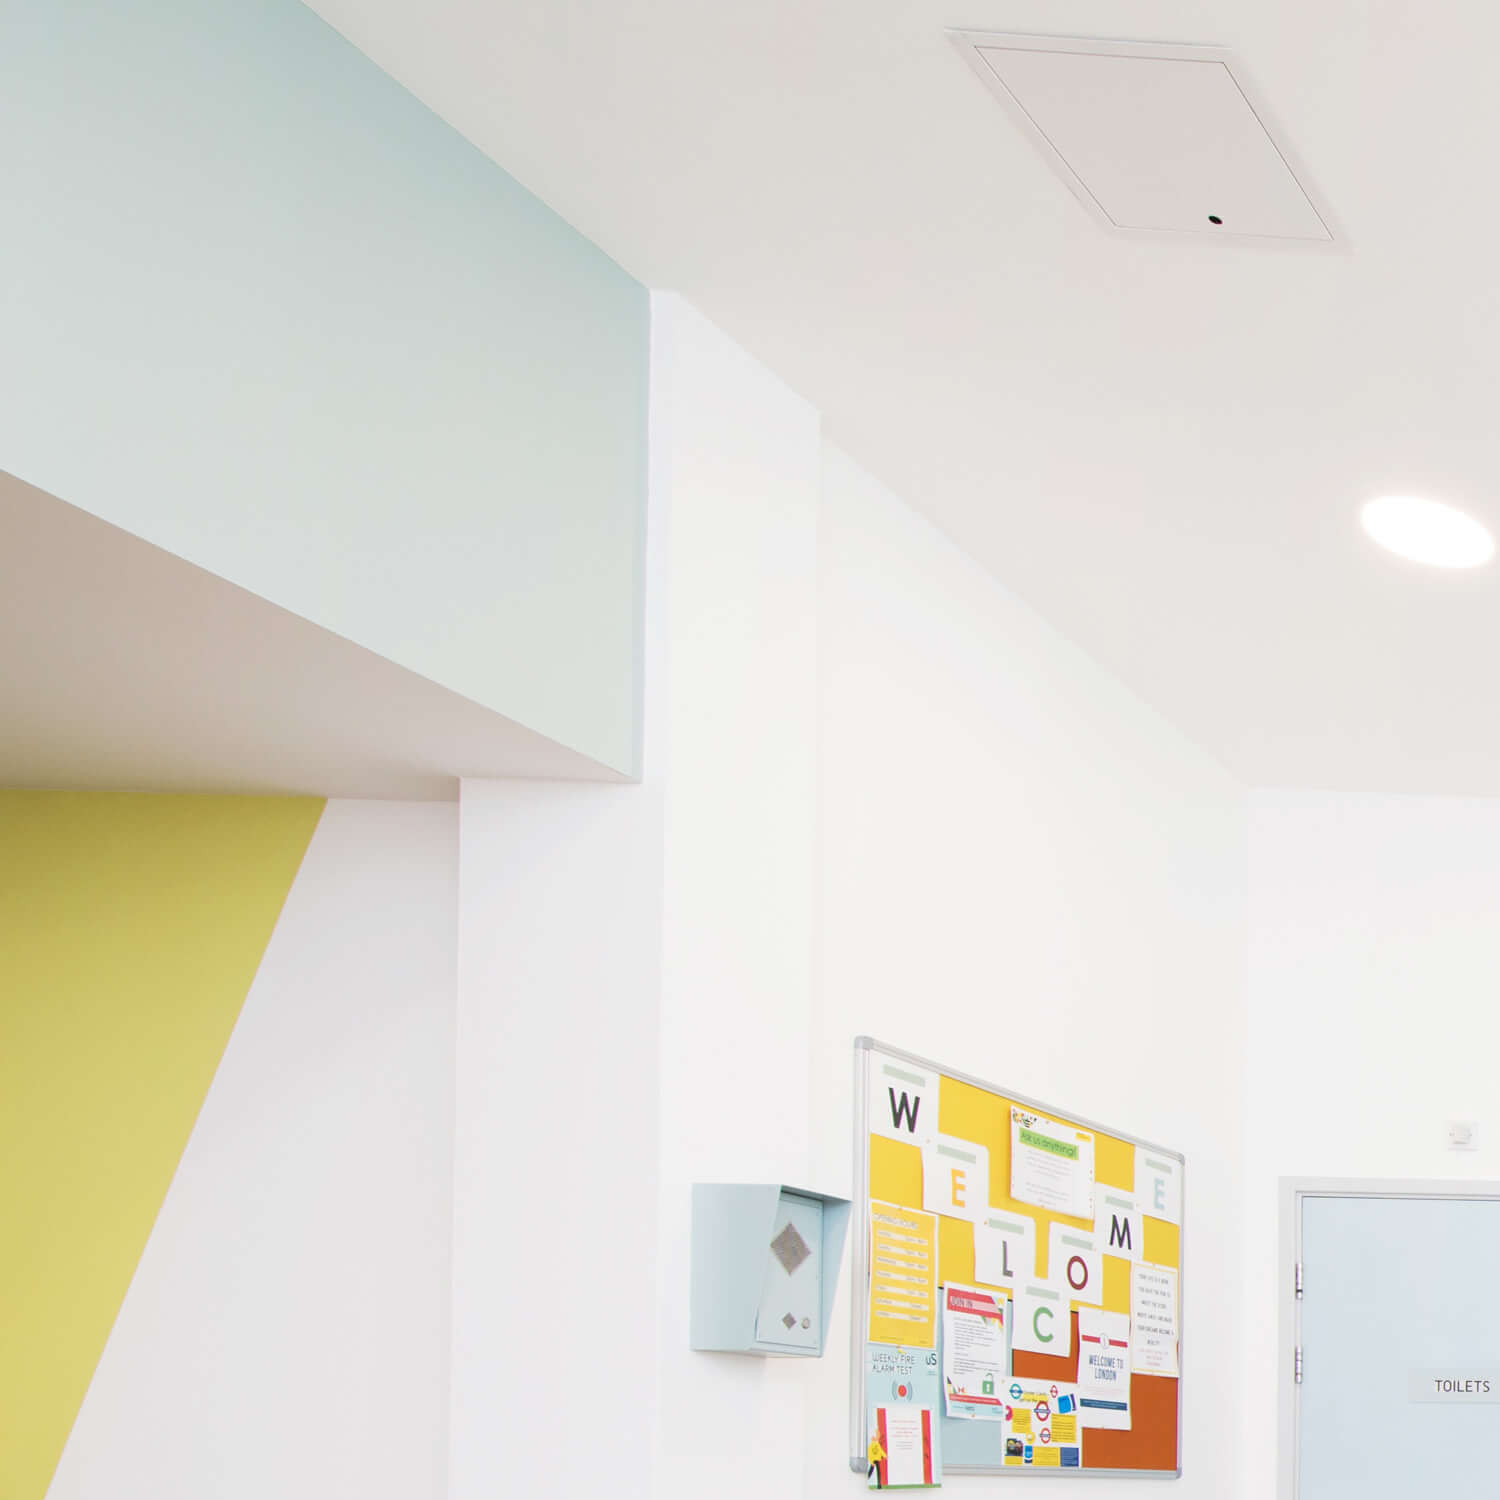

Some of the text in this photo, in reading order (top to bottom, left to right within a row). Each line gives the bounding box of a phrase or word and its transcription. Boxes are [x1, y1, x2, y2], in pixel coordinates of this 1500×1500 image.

[872, 1352, 915, 1365] WEEKLY FIRE
[1089, 1354, 1124, 1369] WELCOME TO
[872, 1364, 913, 1375] ALARM TEST
[1094, 1368, 1117, 1381] LONDON
[1434, 1379, 1490, 1393] TOILETS
